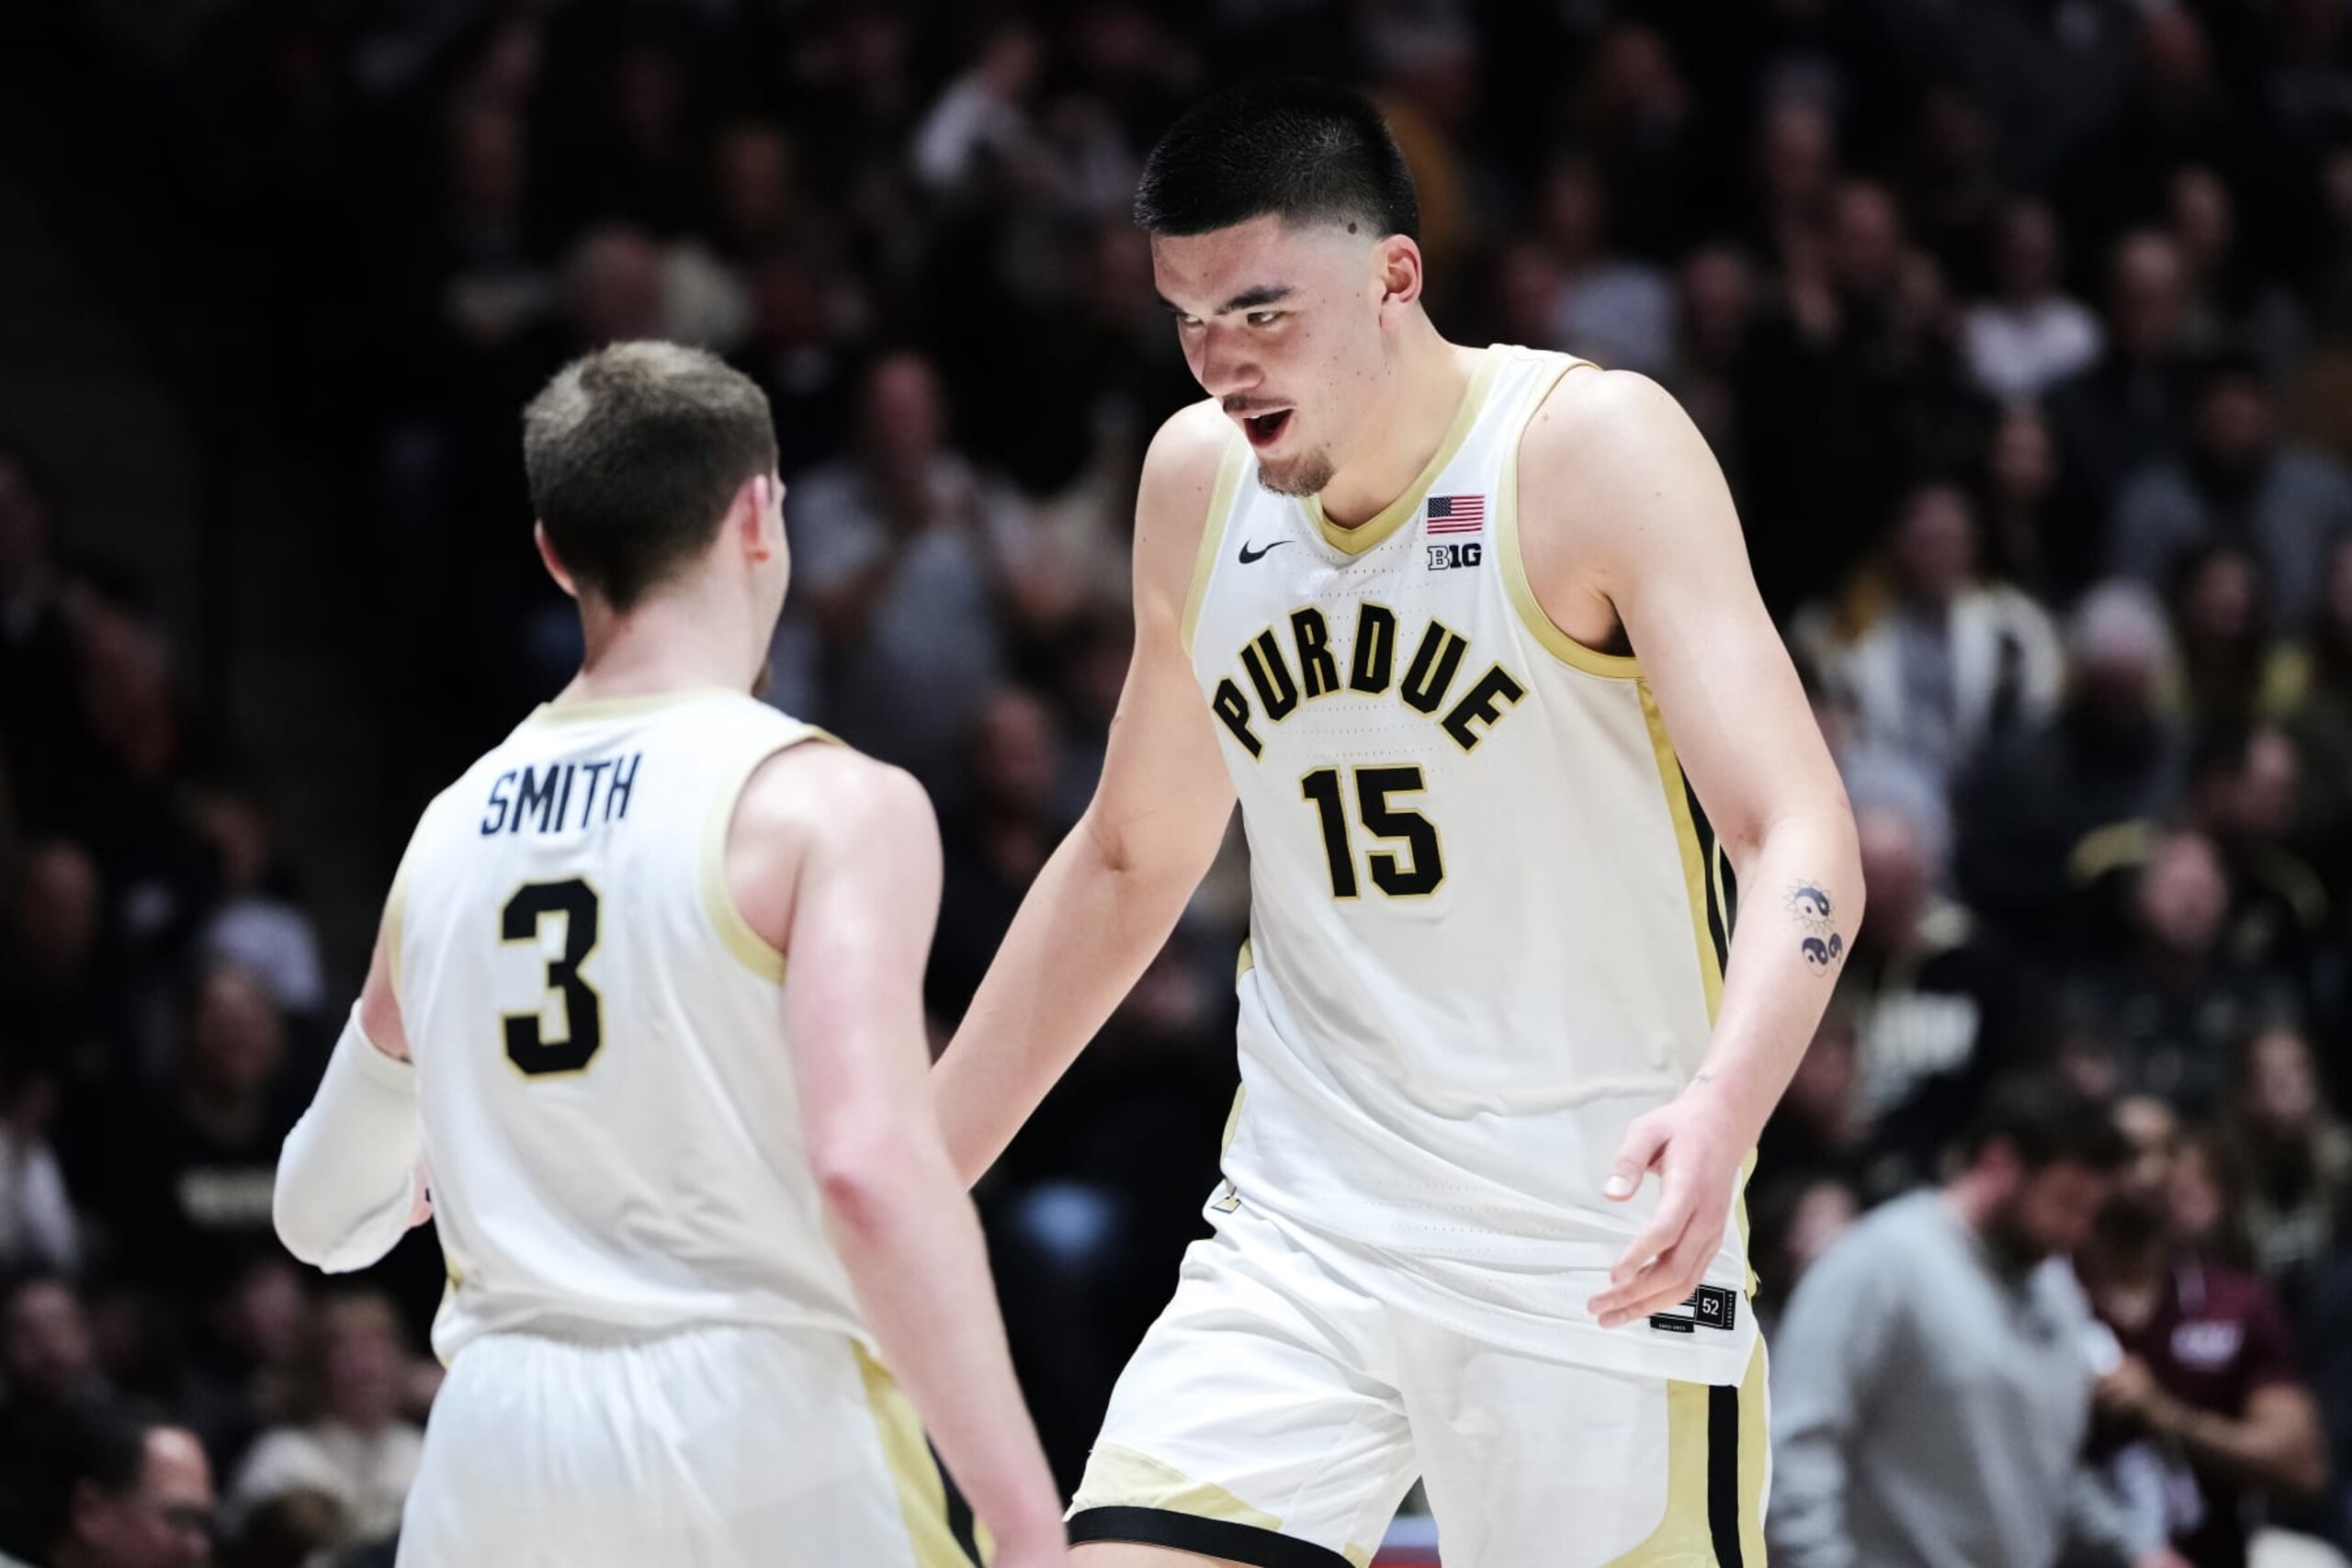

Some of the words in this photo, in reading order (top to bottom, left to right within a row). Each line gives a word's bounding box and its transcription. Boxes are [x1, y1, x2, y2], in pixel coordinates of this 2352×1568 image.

[1212, 598, 1529, 763] PURDUE
[481, 751, 641, 836] SMITH
[1299, 763, 1447, 901] 15
[499, 876, 605, 1082] 3
[1702, 1297, 1719, 1315] 52
